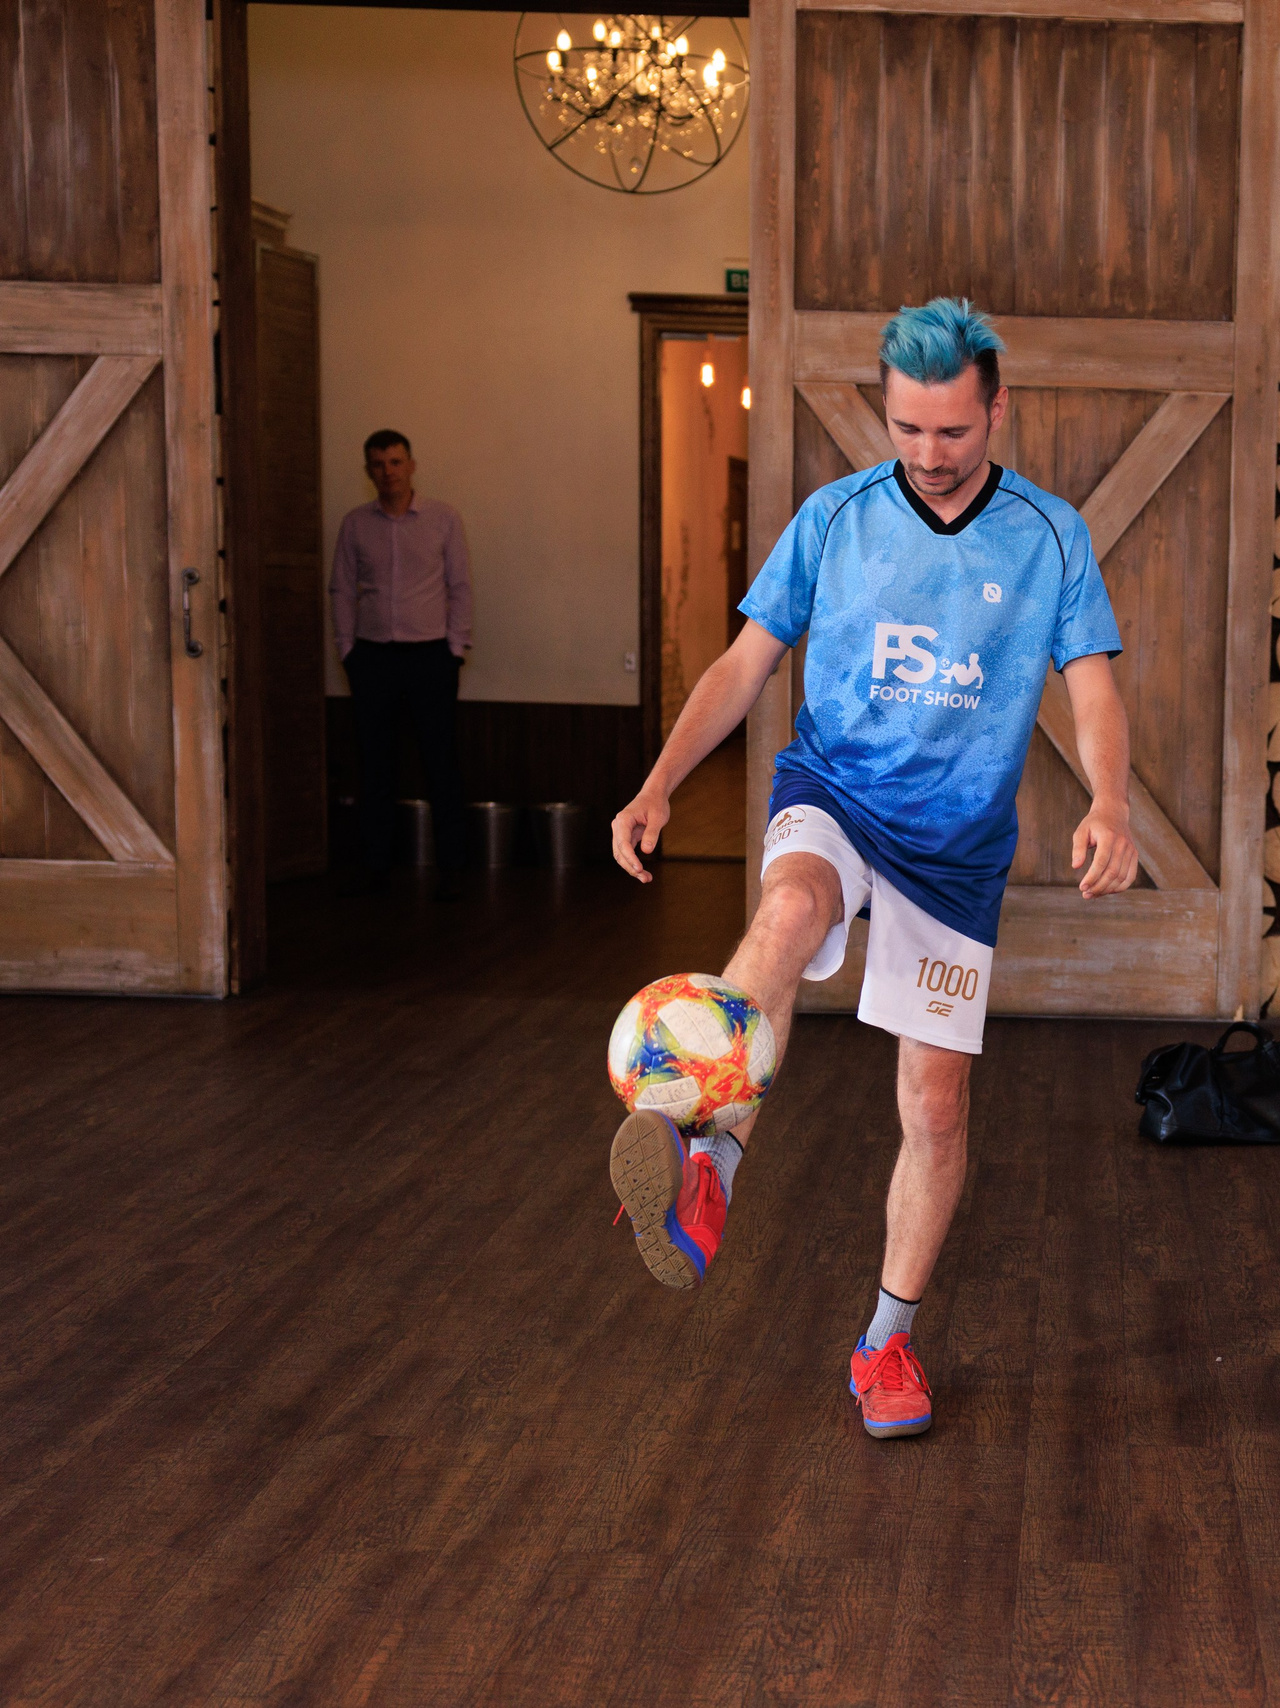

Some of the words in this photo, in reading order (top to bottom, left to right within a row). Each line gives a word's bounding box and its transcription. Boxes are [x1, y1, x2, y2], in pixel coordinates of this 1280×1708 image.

[871, 622, 939, 684] FS
[869, 684, 921, 704] FOOT
[923, 690, 981, 710] SHOW
[917, 957, 979, 1001] 1000
